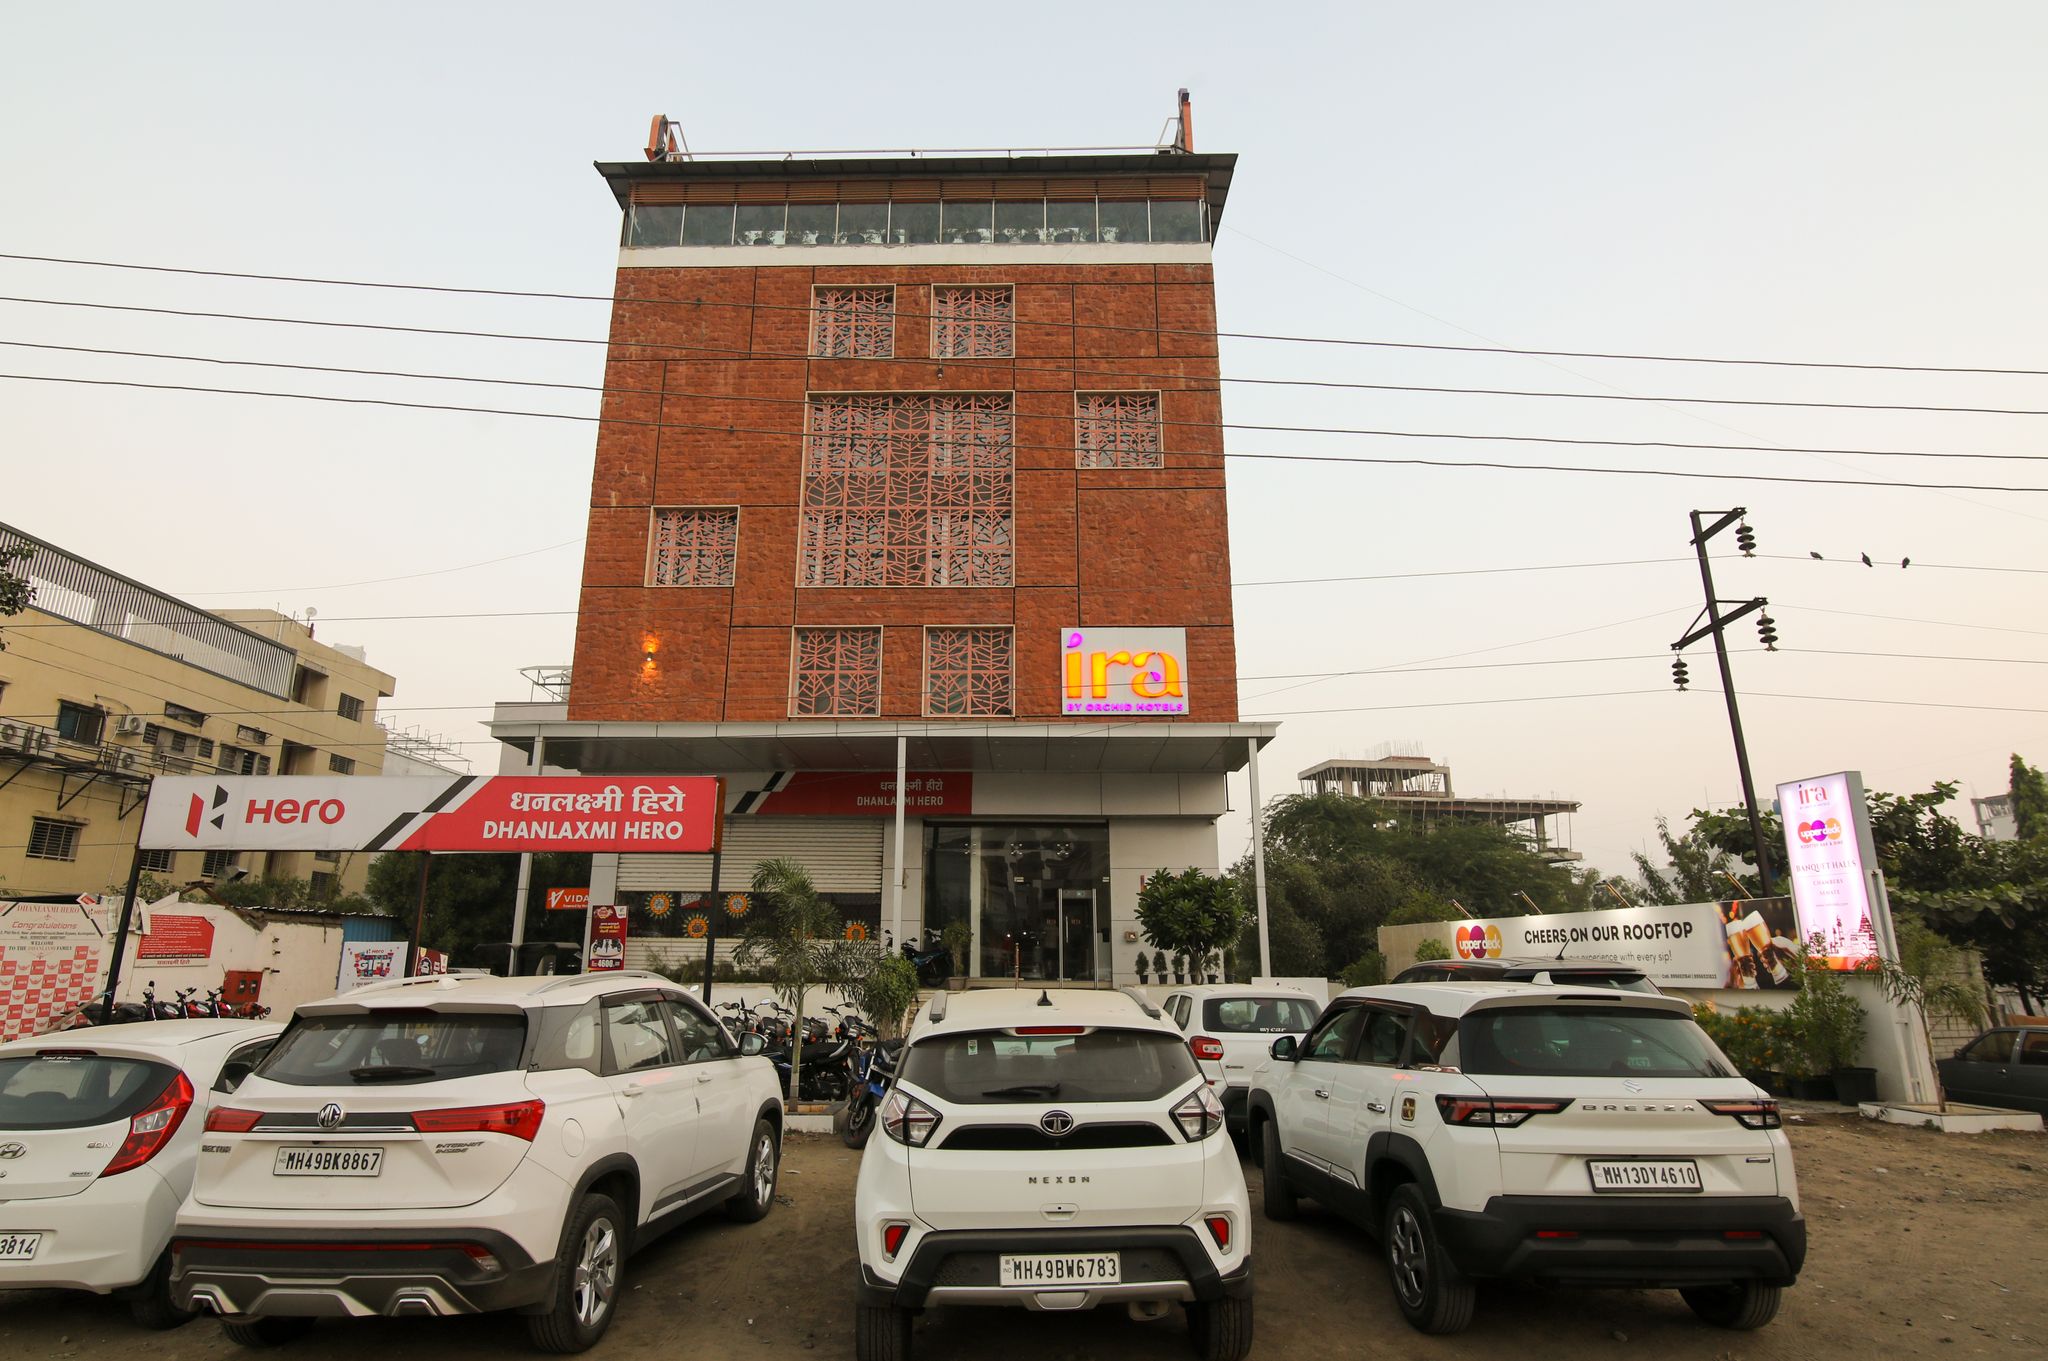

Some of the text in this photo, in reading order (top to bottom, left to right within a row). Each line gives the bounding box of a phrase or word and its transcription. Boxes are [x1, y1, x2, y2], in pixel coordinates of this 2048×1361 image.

[1066, 632, 1183, 698] ira
[1066, 703, 1184, 712] BY ORCHID HOTELS
[510, 785, 686, 815] धनलक्ष्मी हिरो
[857, 796, 943, 806] DHANLAMI HERO
[1798, 784, 1828, 804] ira
[245, 799, 345, 824] Hero
[483, 820, 683, 840] DHANLAXMI HERO
[1801, 829, 1822, 839] upper
[12, 921, 78, 930] Congratulations
[1525, 922, 1693, 944] CHEERS ON OUR ROOFTOP
[1460, 940, 1481, 953] upper
[359, 959, 392, 973] GIFT
[1620, 952, 1635, 960] with
[1637, 953, 1656, 964] every
[1658, 950, 1672, 964] sip!
[321, 1105, 341, 1127] MG
[286, 1152, 380, 1170] MH49BK8867
[1029, 1176, 1090, 1184] NEXON
[1603, 1166, 1695, 1184] MH13DY4610
[1013, 1258, 1116, 1279] MH49BW6783
